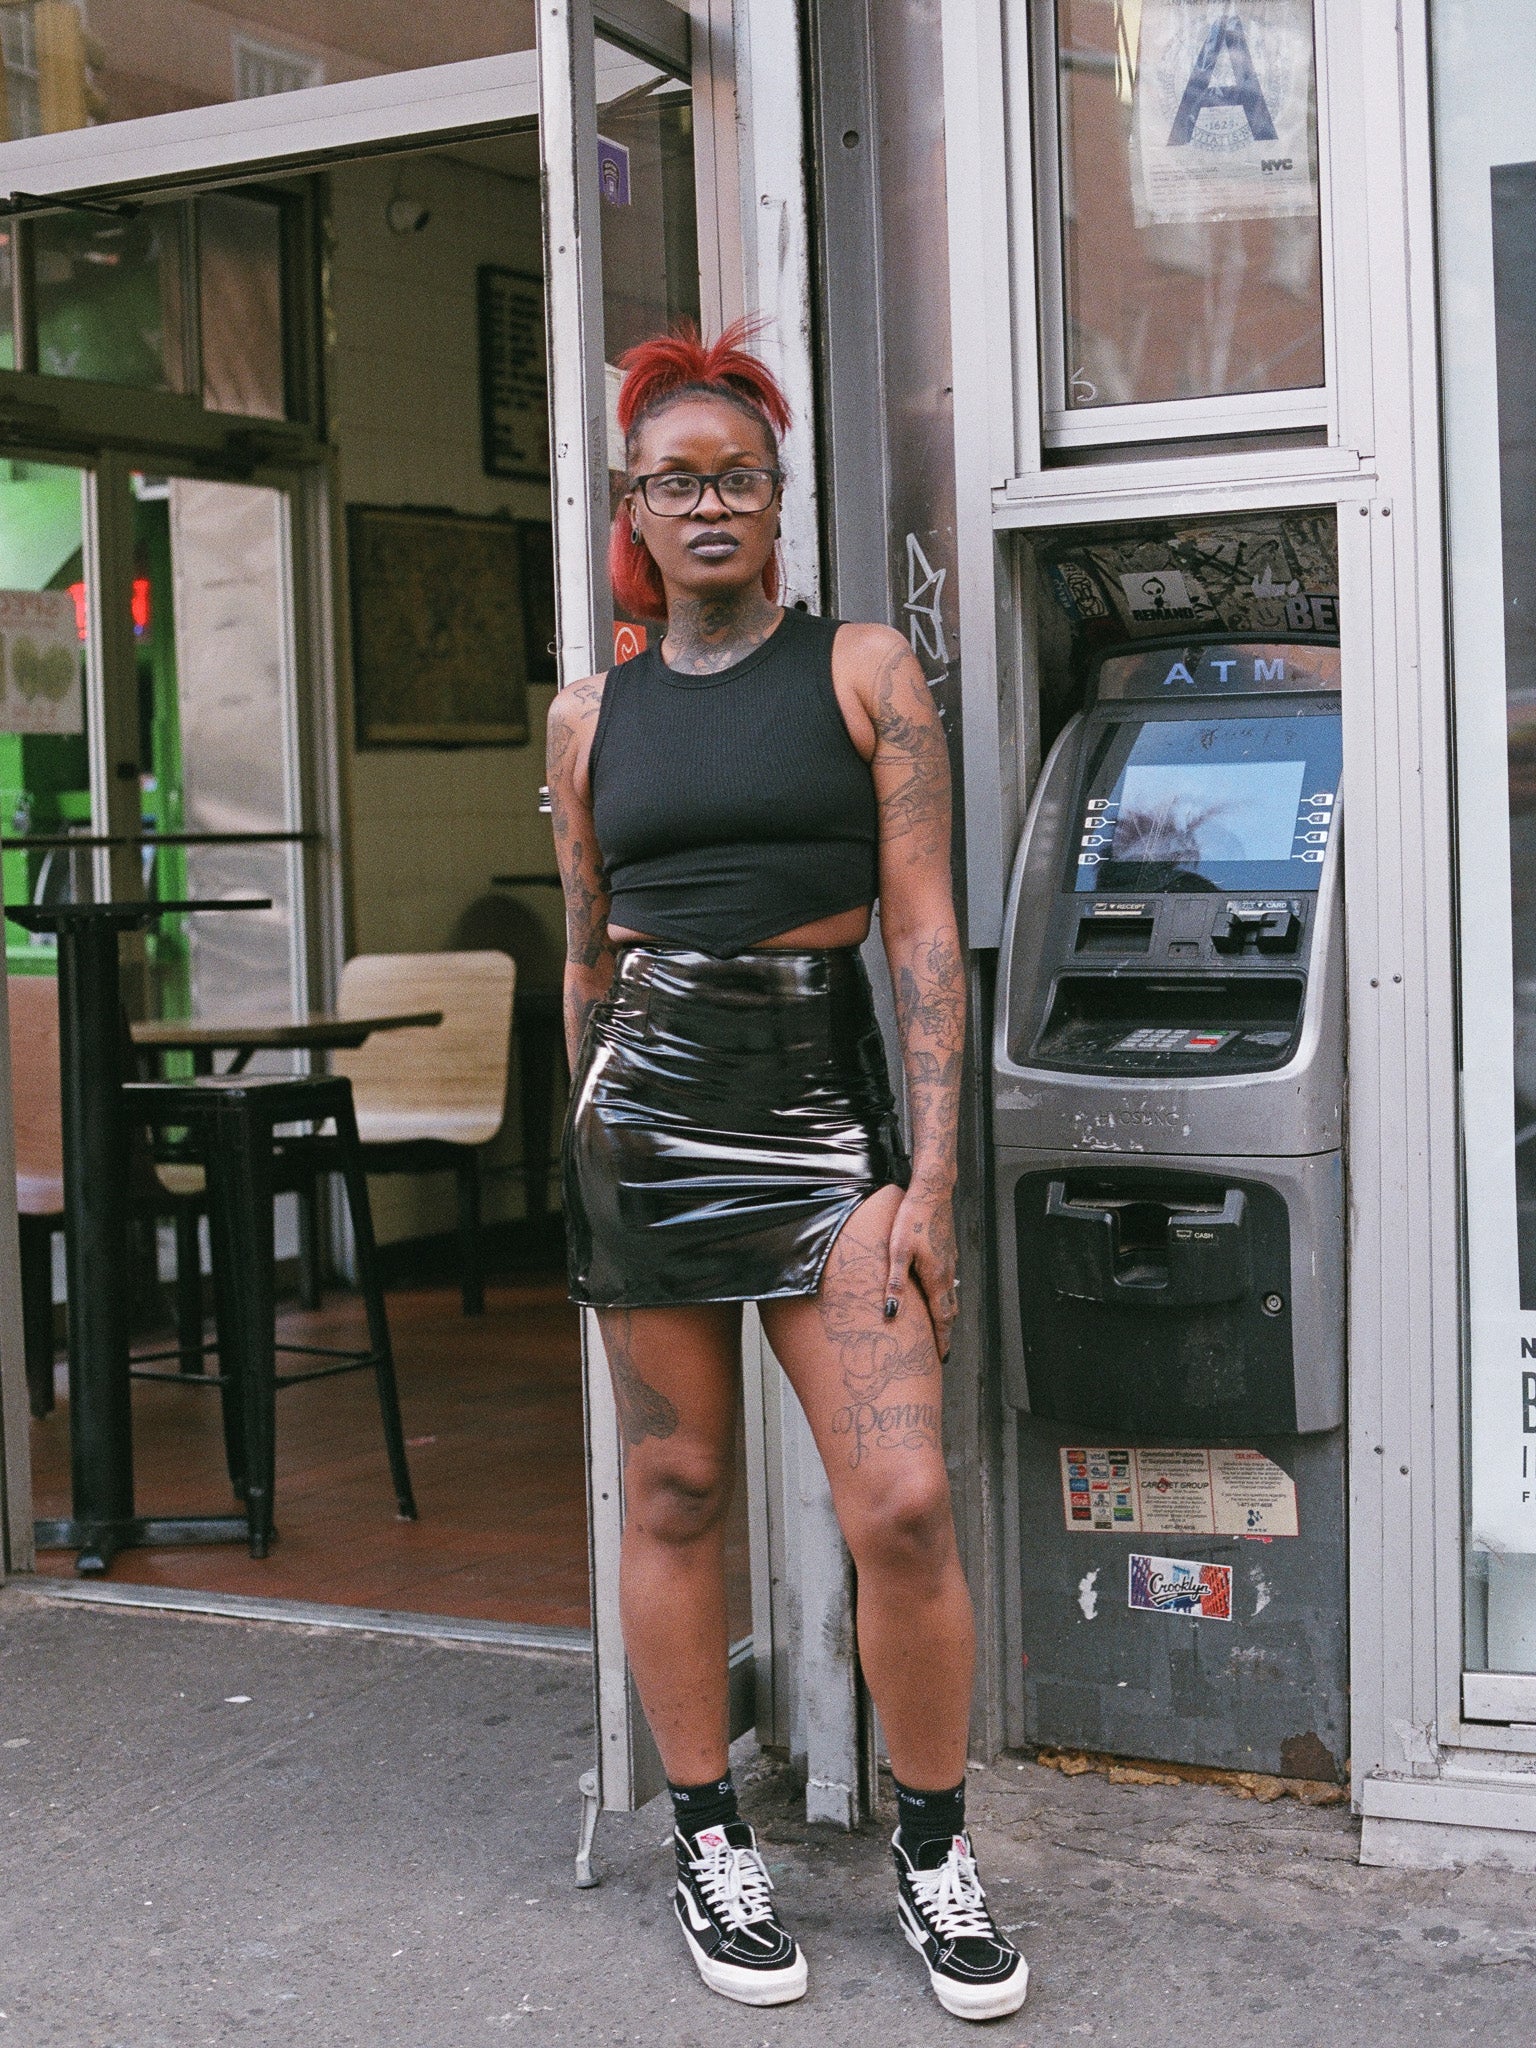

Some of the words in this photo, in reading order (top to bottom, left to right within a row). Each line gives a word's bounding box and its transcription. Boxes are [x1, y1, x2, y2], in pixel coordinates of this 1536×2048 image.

[1167, 14, 1279, 147] A
[1260, 158, 1293, 172] NYC
[1286, 593, 1339, 630] BE
[1163, 658, 1285, 685] ATM
[1180, 1481, 1209, 1489] GROUP
[1149, 1573, 1211, 1601] Crooklyn
